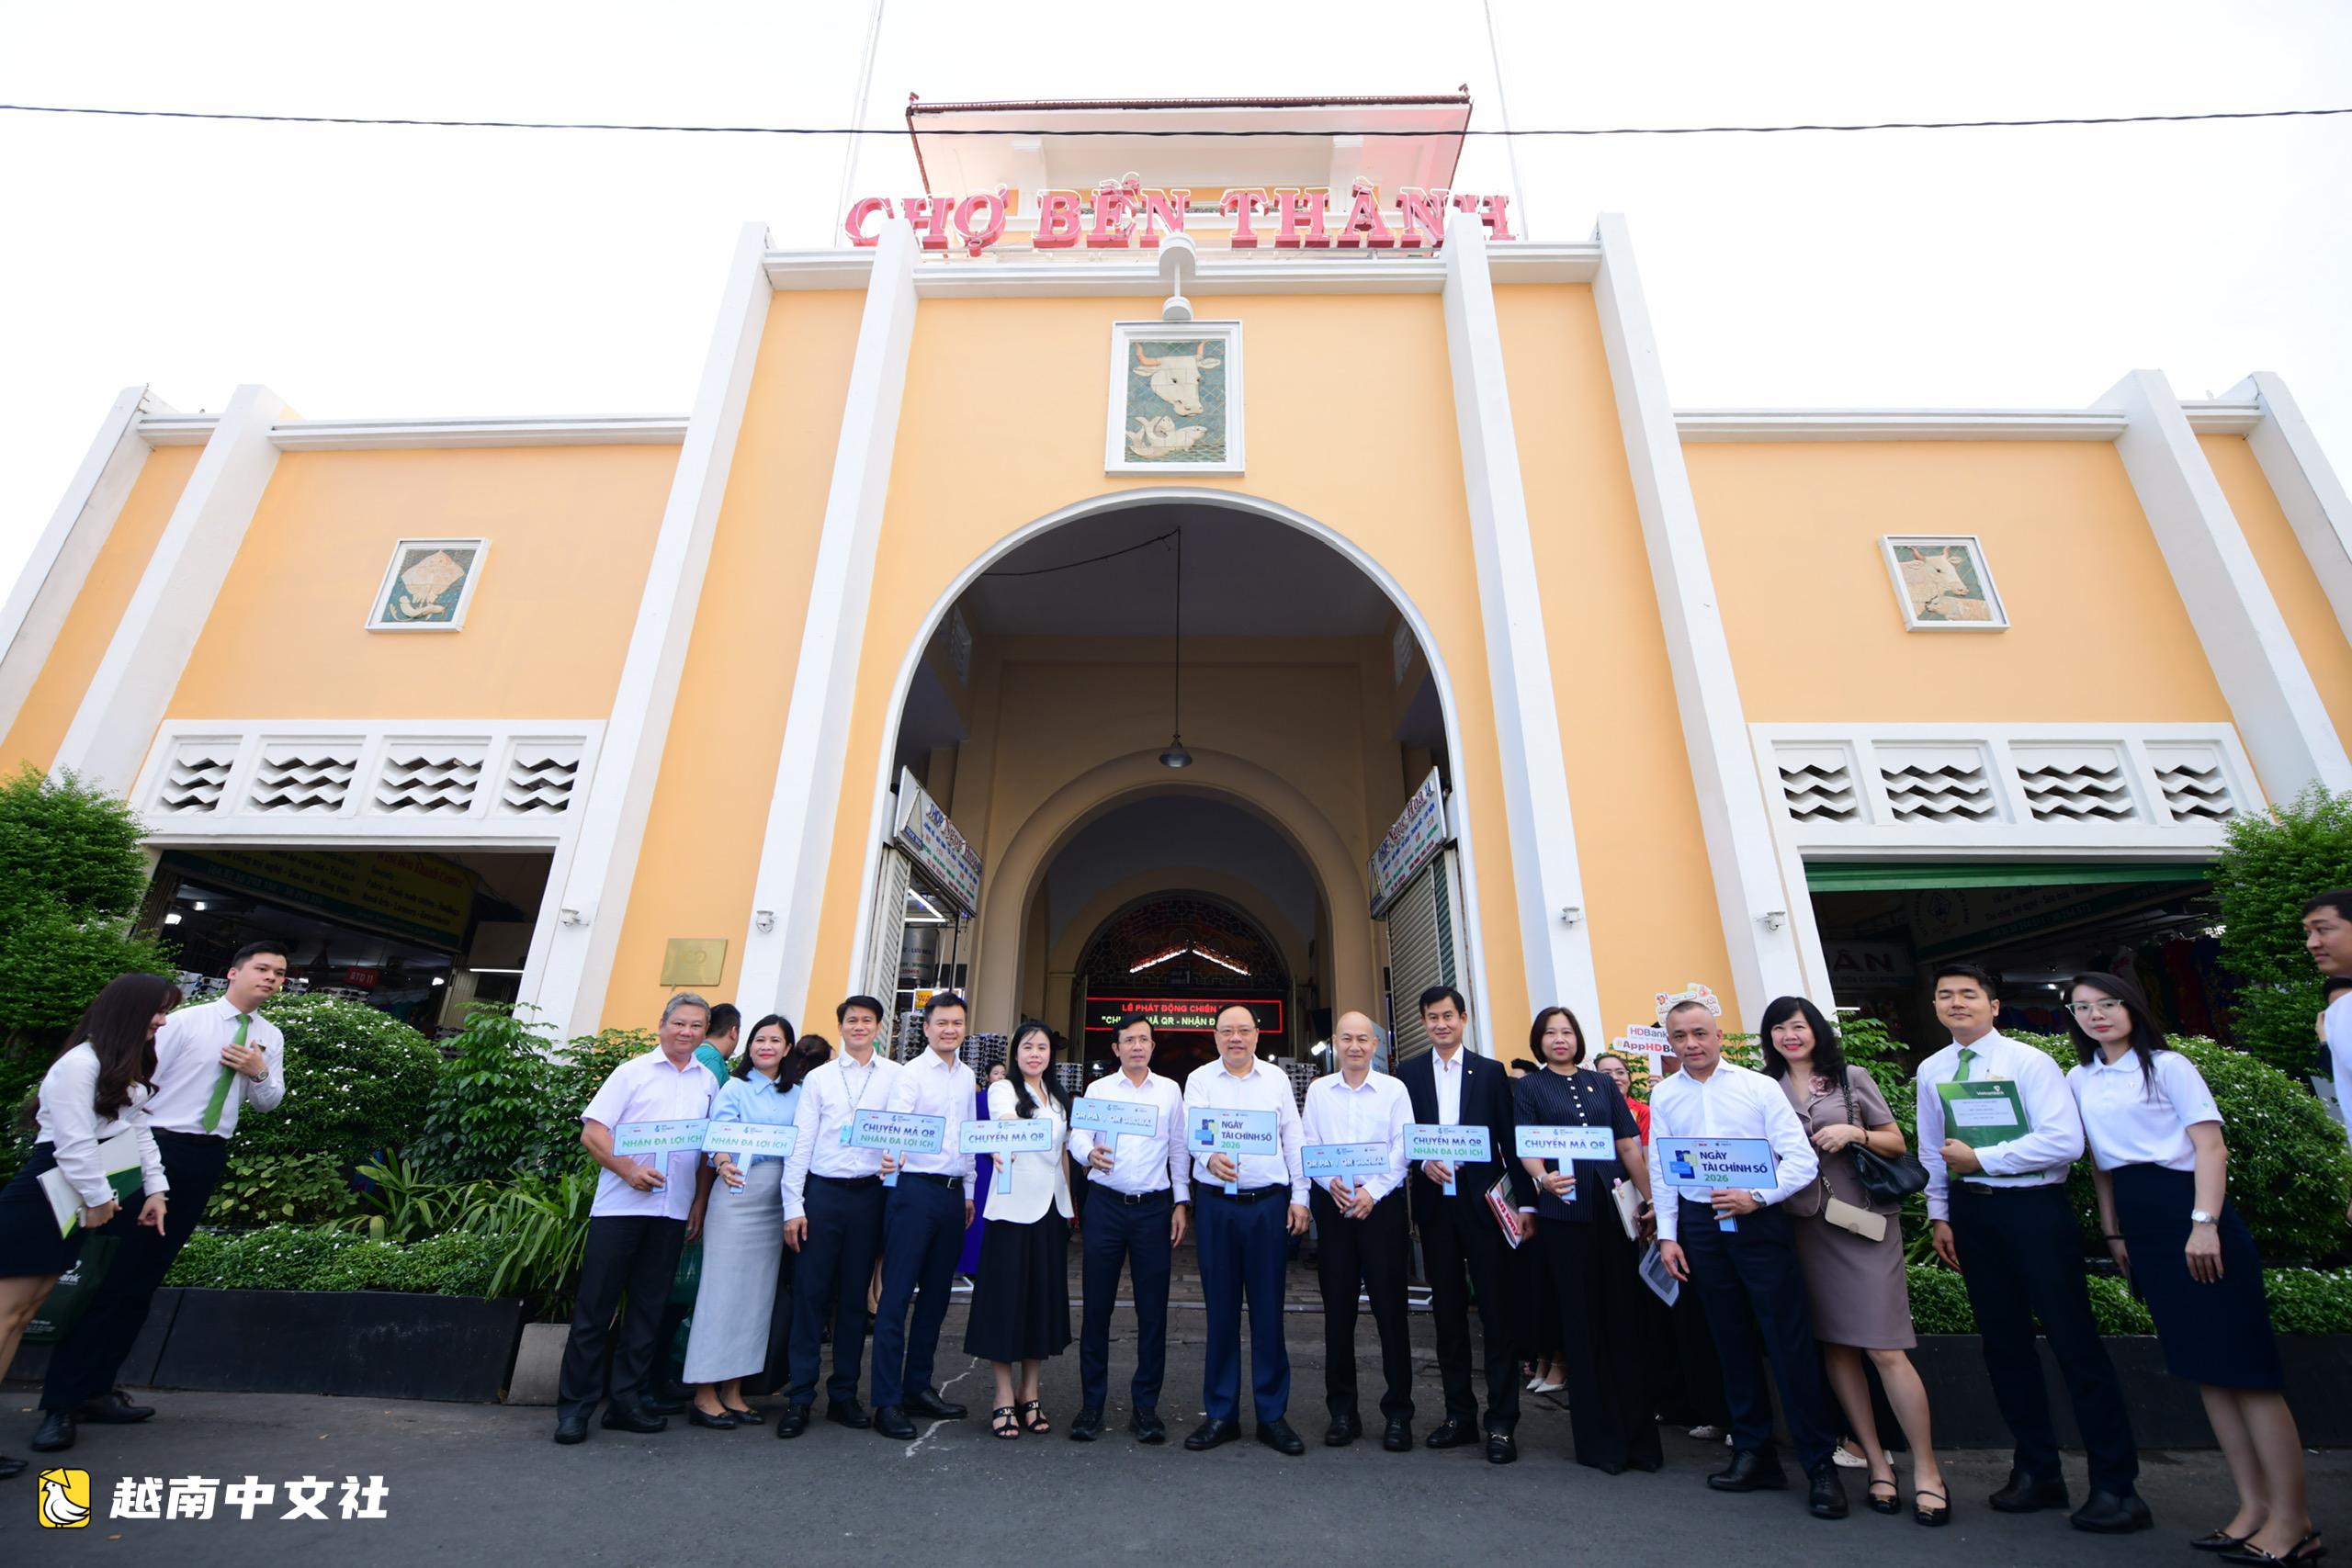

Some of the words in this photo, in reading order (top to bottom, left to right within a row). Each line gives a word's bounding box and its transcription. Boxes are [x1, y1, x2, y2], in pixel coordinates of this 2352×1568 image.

[845, 183, 1009, 257] CHỢ
[1033, 171, 1191, 248] BẾN
[1220, 175, 1516, 248] THÀNH
[1136, 1002, 1159, 1012] PHÁT
[1161, 1002, 1188, 1014] ĐỘNG
[1190, 1004, 1216, 1013] CHIẾN
[1160, 1017, 1174, 1025] QR
[1182, 1016, 1207, 1027] NHẬN
[1630, 1028, 1668, 1039] HDBank
[1221, 1121, 1244, 1130] NGÀY
[921, 1129, 935, 1138] QR
[1030, 1133, 1045, 1142] QR
[1221, 1131, 1234, 1139] TÀI
[1234, 1131, 1261, 1141] CHÍNH
[1261, 1132, 1272, 1142] SỐ
[1221, 1141, 1241, 1149] 2026
[1469, 1138, 1482, 1146] QR
[1589, 1141, 1606, 1150] QR
[1700, 1149, 1727, 1160] NGÀY
[1702, 1161, 1718, 1172] TÀI
[1719, 1161, 1752, 1173] CHÍNH
[1753, 1162, 1768, 1174] SỐ
[1704, 1174, 1729, 1183] 2026
